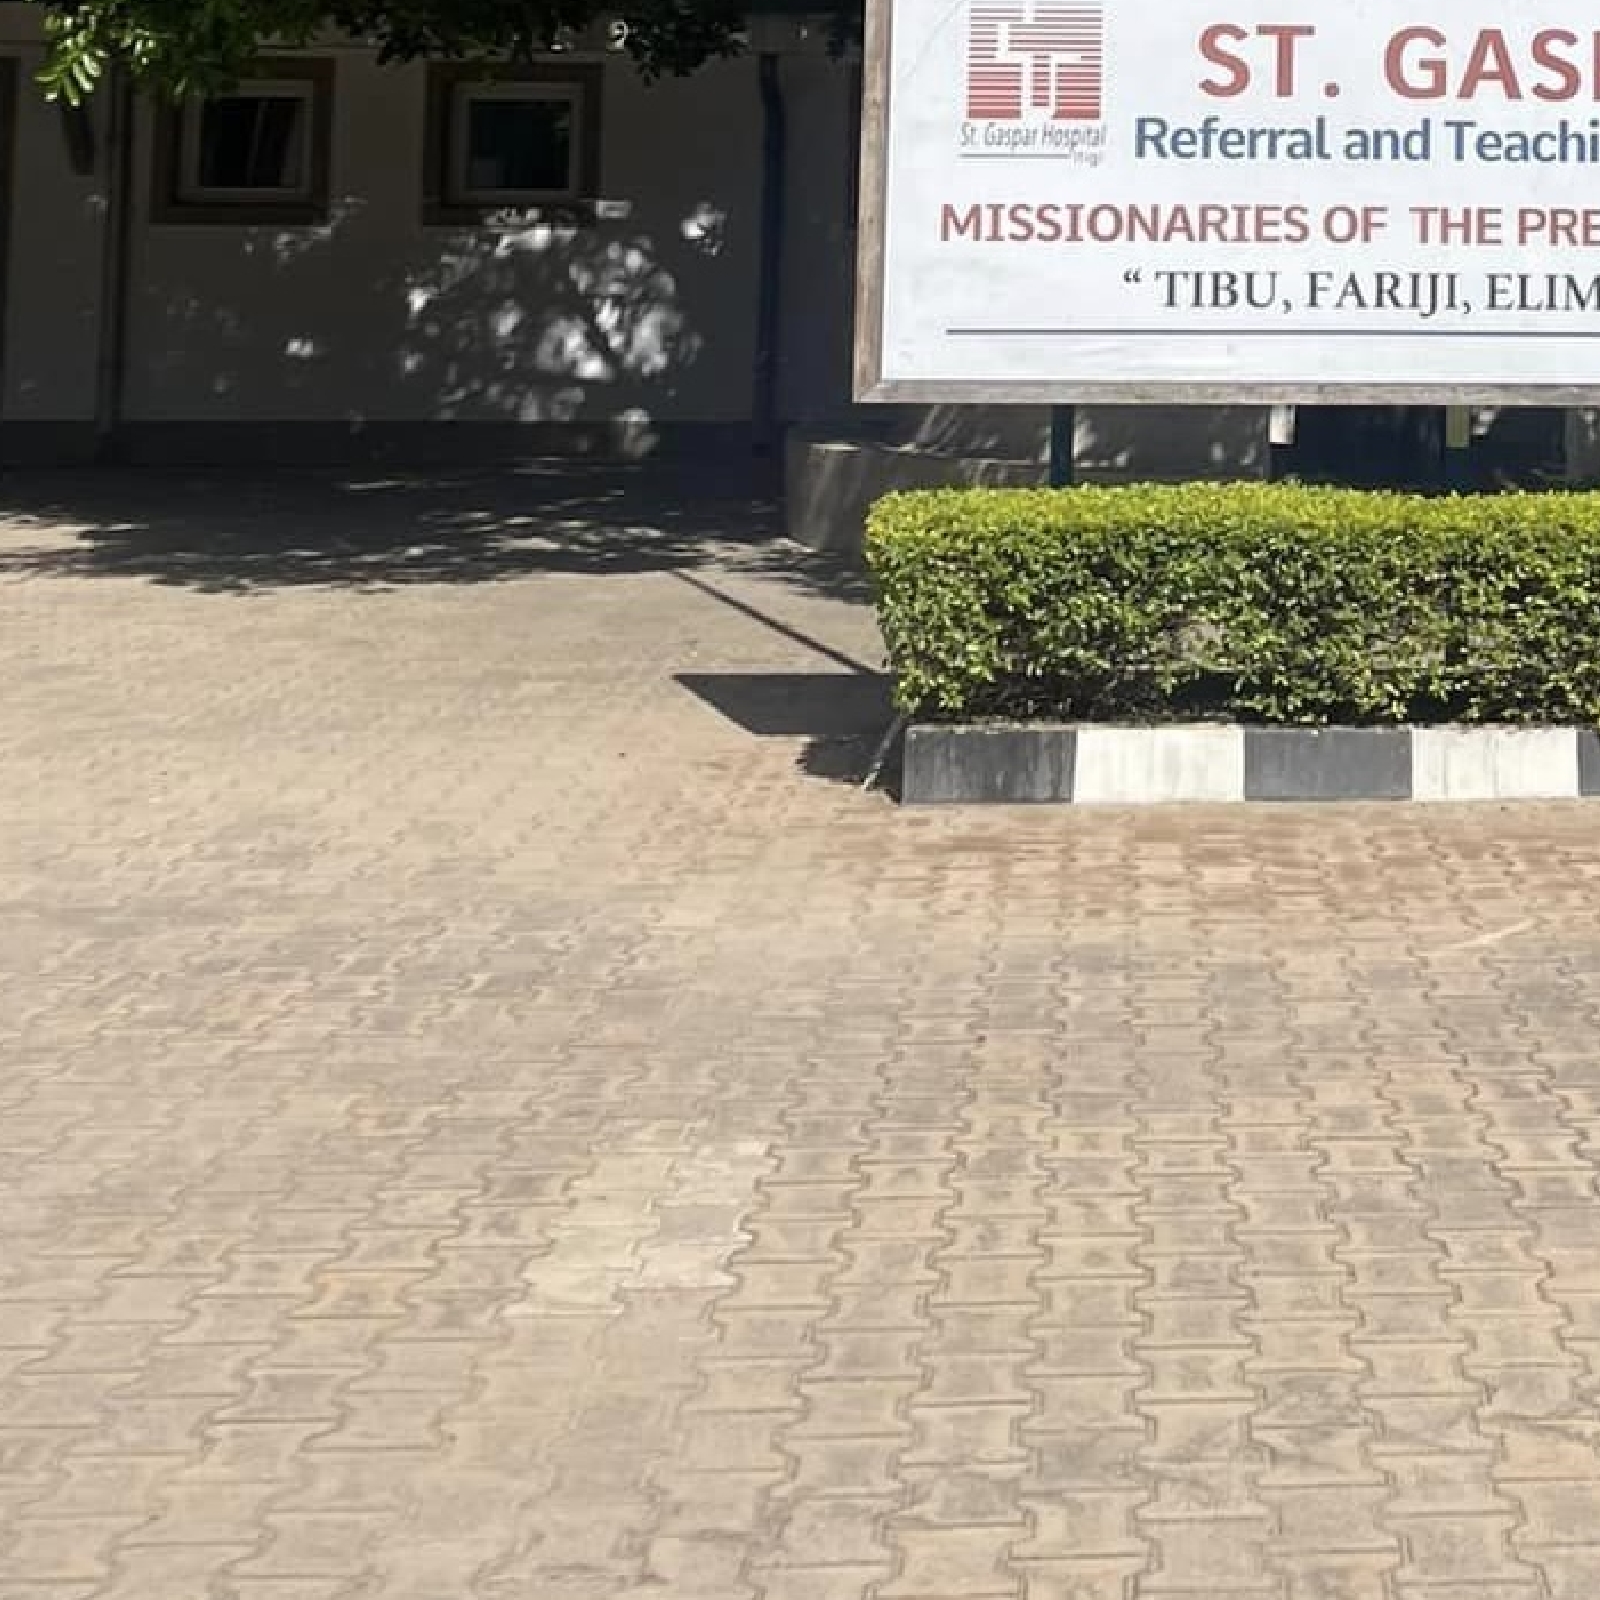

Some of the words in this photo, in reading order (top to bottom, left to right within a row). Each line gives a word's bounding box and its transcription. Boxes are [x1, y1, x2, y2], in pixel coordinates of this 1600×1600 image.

[1198, 22, 1340, 99] ST.
[1134, 116, 1331, 161] Referral
[1342, 117, 1431, 162] and
[943, 203, 1310, 243] MISSIONARIES
[1324, 205, 1388, 244] OF
[1408, 206, 1502, 245] THE
[1307, 272, 1472, 317] FARIJI,
